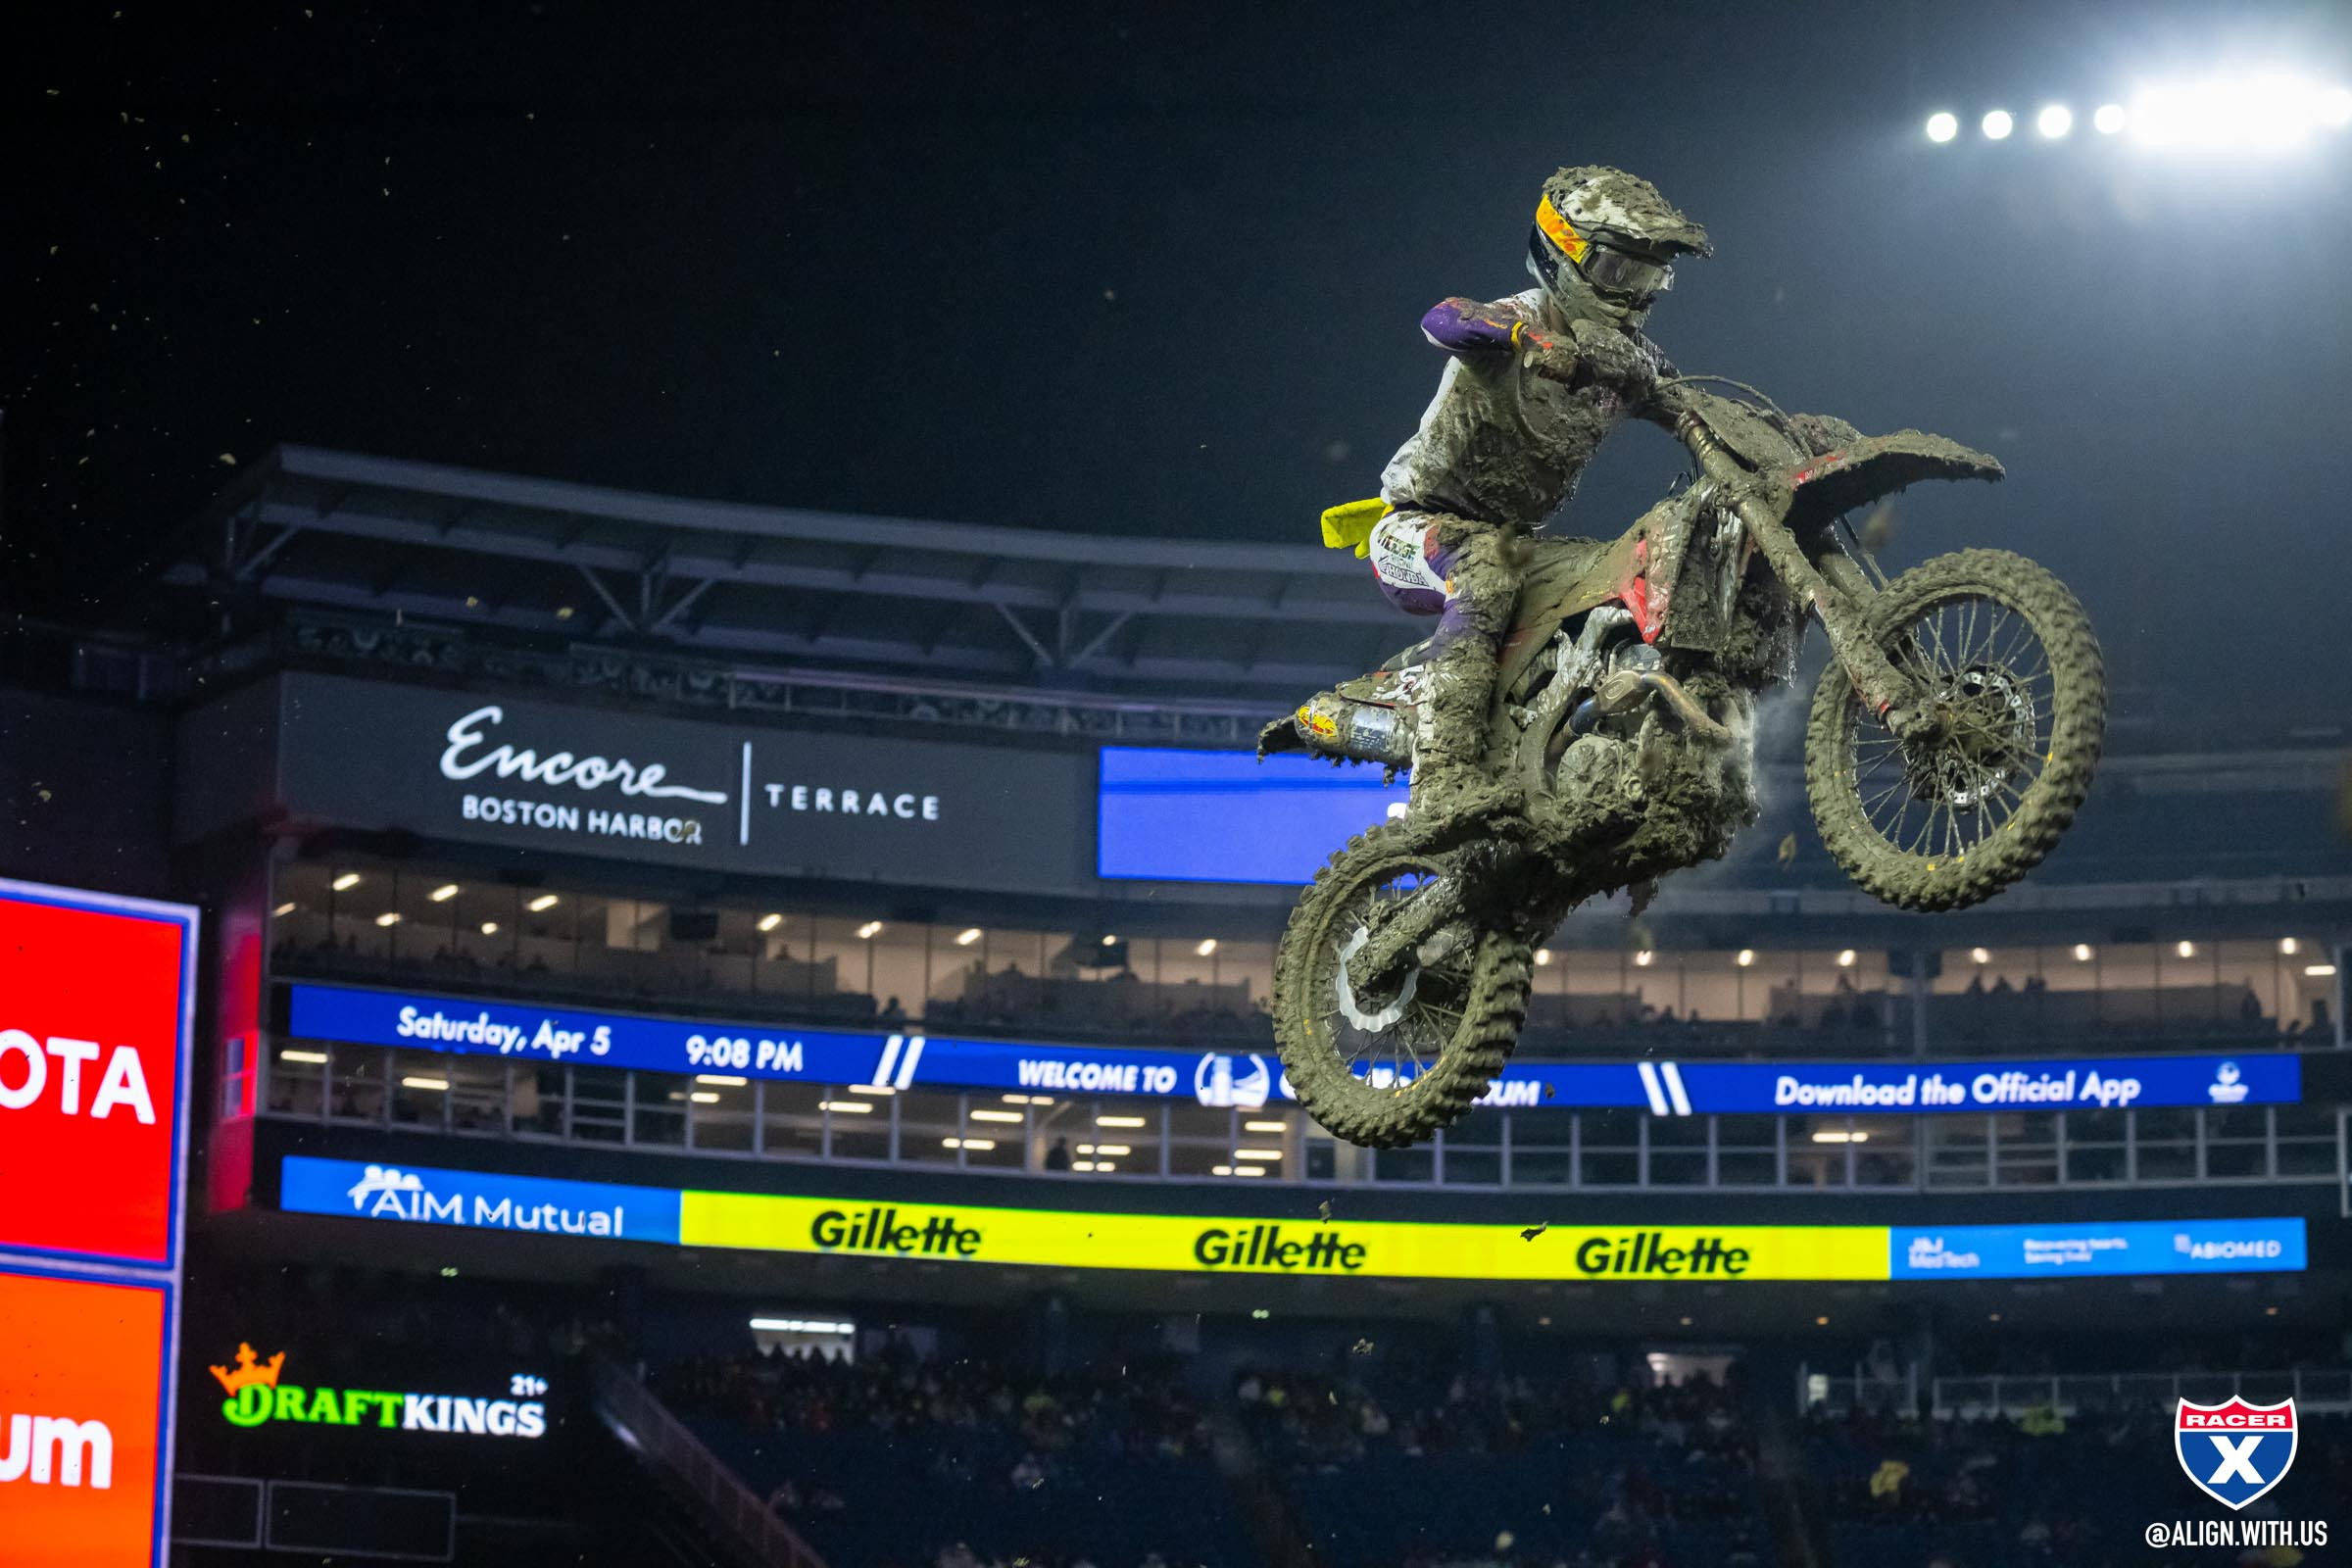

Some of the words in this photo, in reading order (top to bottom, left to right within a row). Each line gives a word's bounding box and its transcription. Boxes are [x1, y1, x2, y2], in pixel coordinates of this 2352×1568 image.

[1386, 563, 1429, 587] HONDA
[440, 706, 727, 804] Encore
[463, 795, 579, 831] BOSTON
[587, 809, 703, 846] HARBOR
[765, 783, 940, 820] TERRACE
[396, 1005, 525, 1054] Saturday,
[531, 1018, 585, 1059] Apr
[590, 1025, 612, 1056] 5
[686, 1034, 751, 1069] 9:08
[756, 1039, 805, 1072] PM
[1018, 1059, 1139, 1092] WELCOME
[1143, 1065, 1178, 1094] TO
[1775, 1074, 1917, 1106] Download
[1920, 1073, 1966, 1105] the
[1971, 1068, 2076, 1104] Official
[2079, 1070, 2141, 1107] App
[370, 1189, 464, 1225] AIM
[474, 1194, 624, 1238] Mutual
[810, 1207, 983, 1256] Gillette
[1194, 1224, 1367, 1270] Gillette
[1576, 1232, 1750, 1275] Gillette
[2189, 1239, 2282, 1260] ABIOMED
[510, 1373, 549, 1397] 21+
[221, 1382, 546, 1439] DRAFTKINGS
